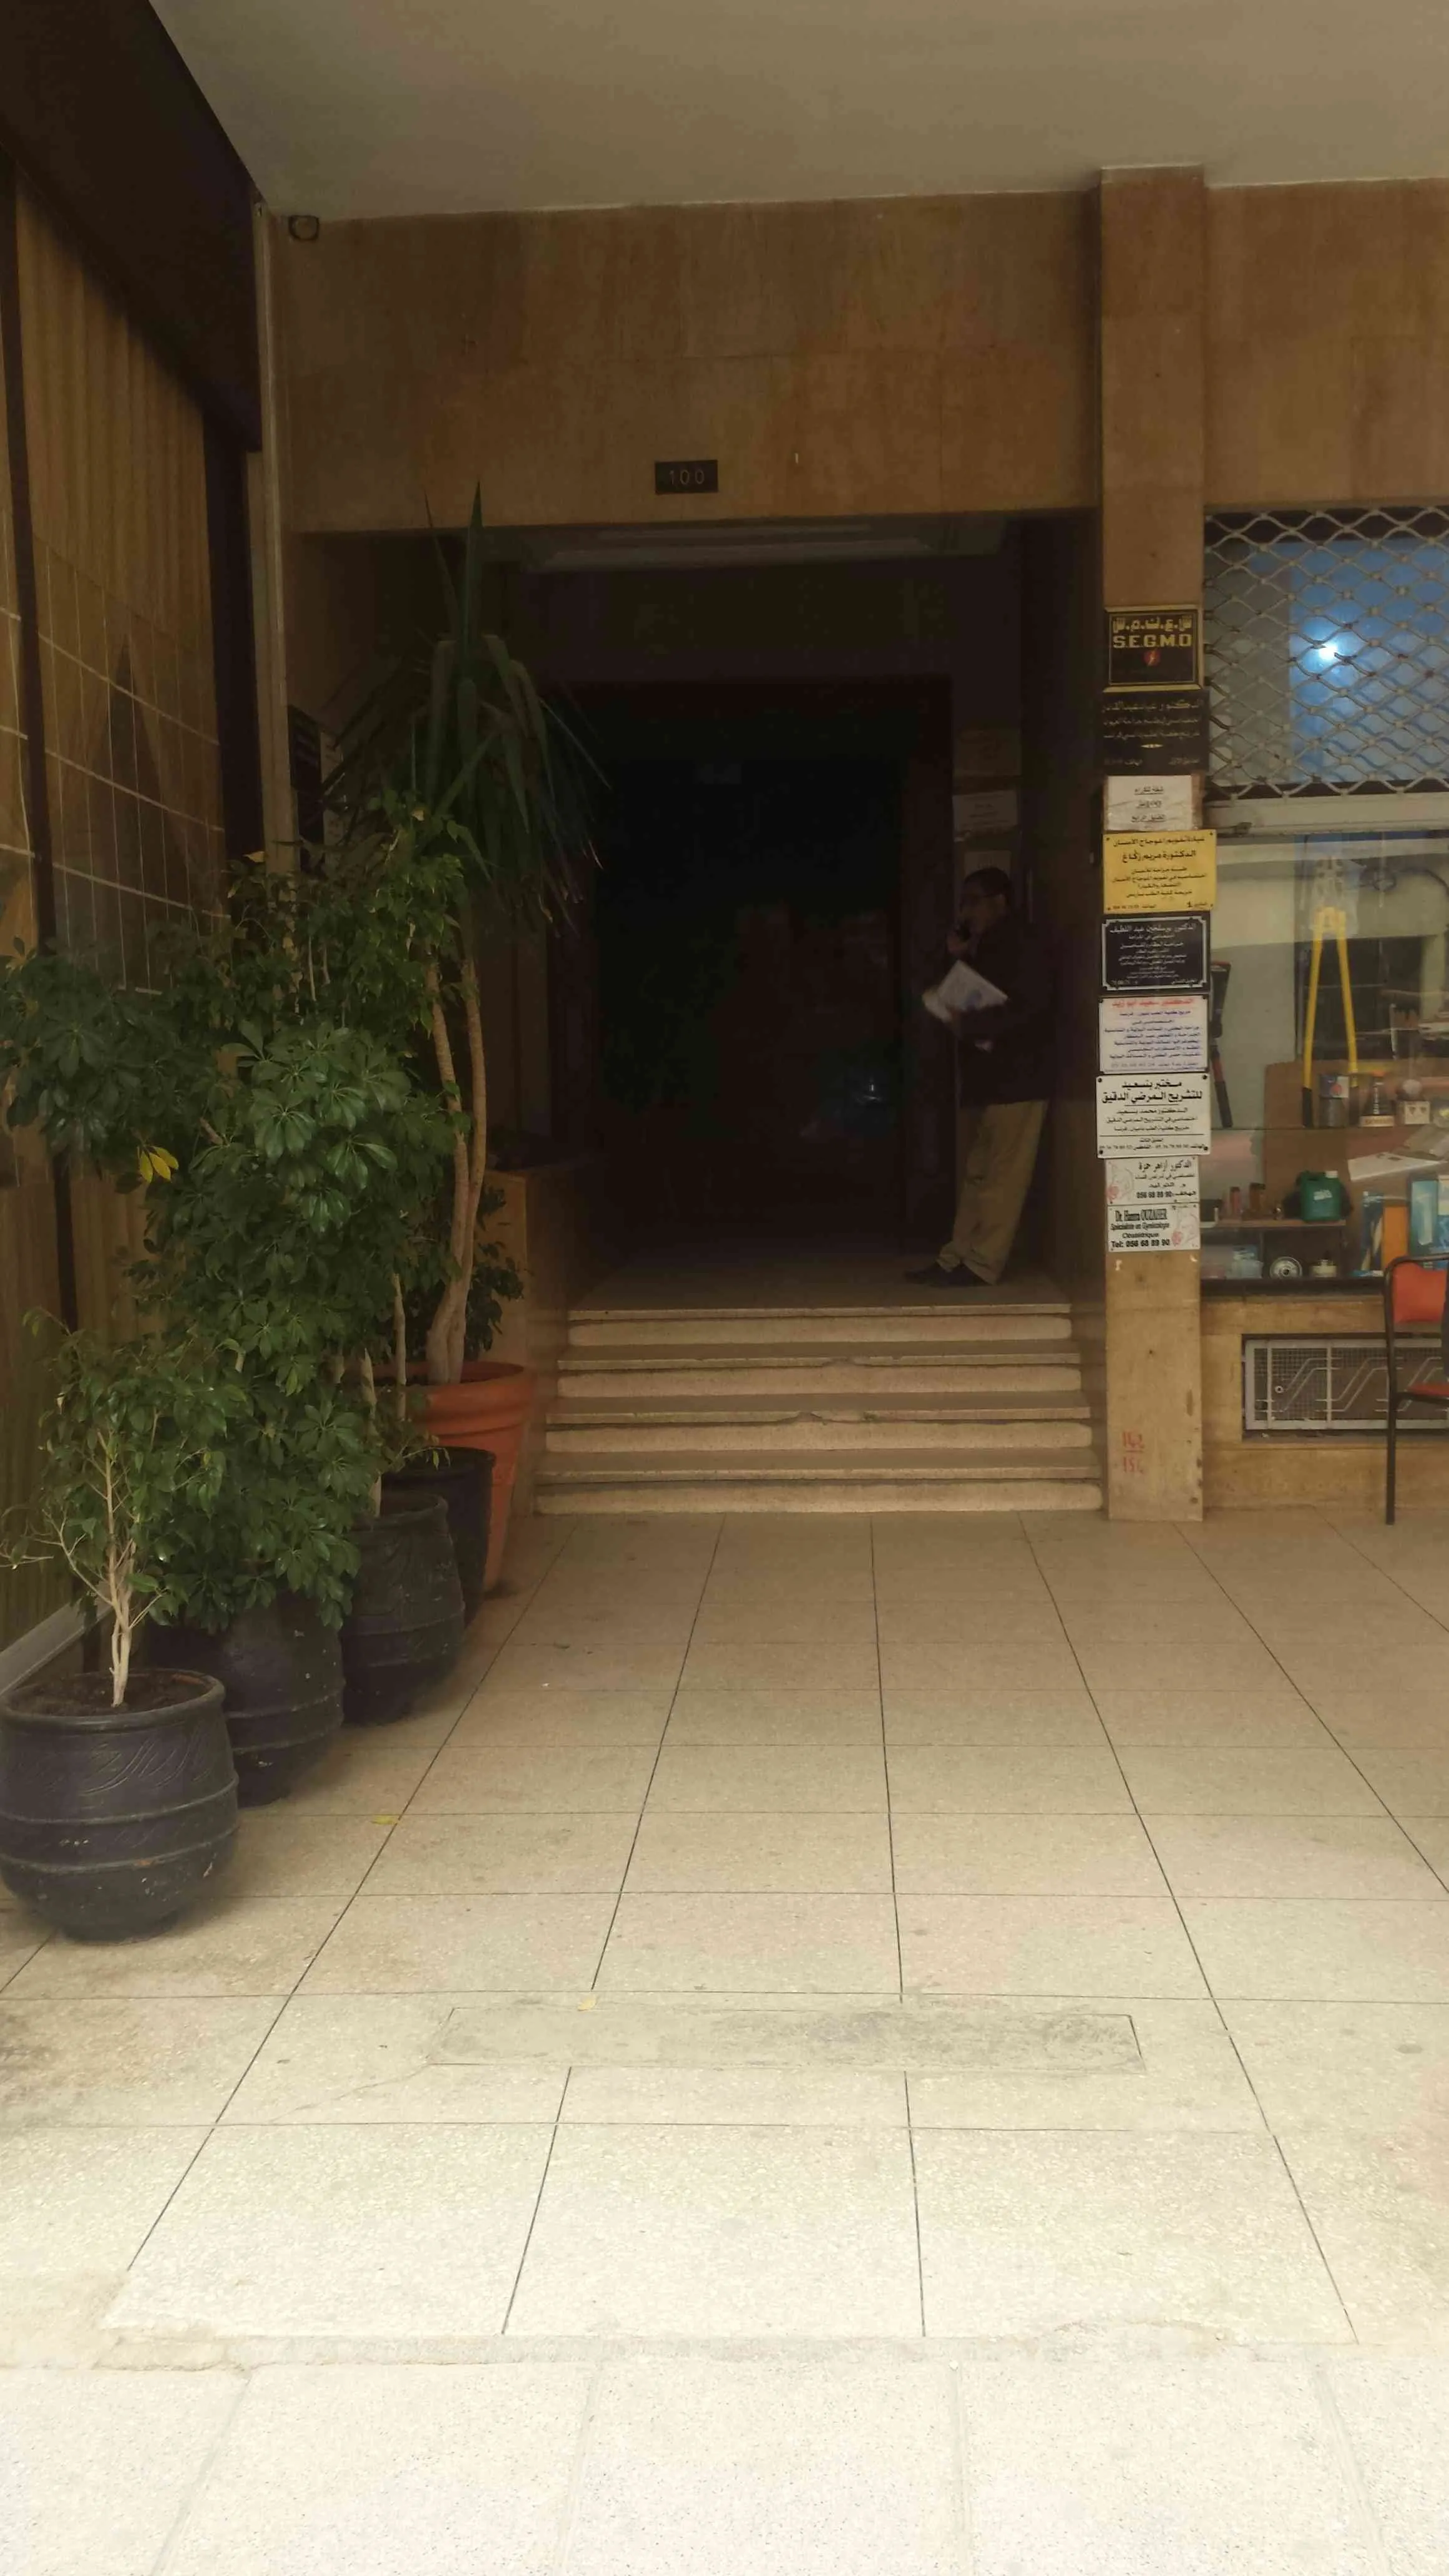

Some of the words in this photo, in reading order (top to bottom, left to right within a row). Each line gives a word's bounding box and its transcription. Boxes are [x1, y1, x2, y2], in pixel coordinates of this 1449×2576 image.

[669, 469, 705, 485] 100
[1113, 634, 1192, 648] SEGMO
[1102, 1091, 1129, 1104] الدقيق
[1131, 1091, 1167, 1103] المرضي
[1168, 1090, 1203, 1103] للتشريح
